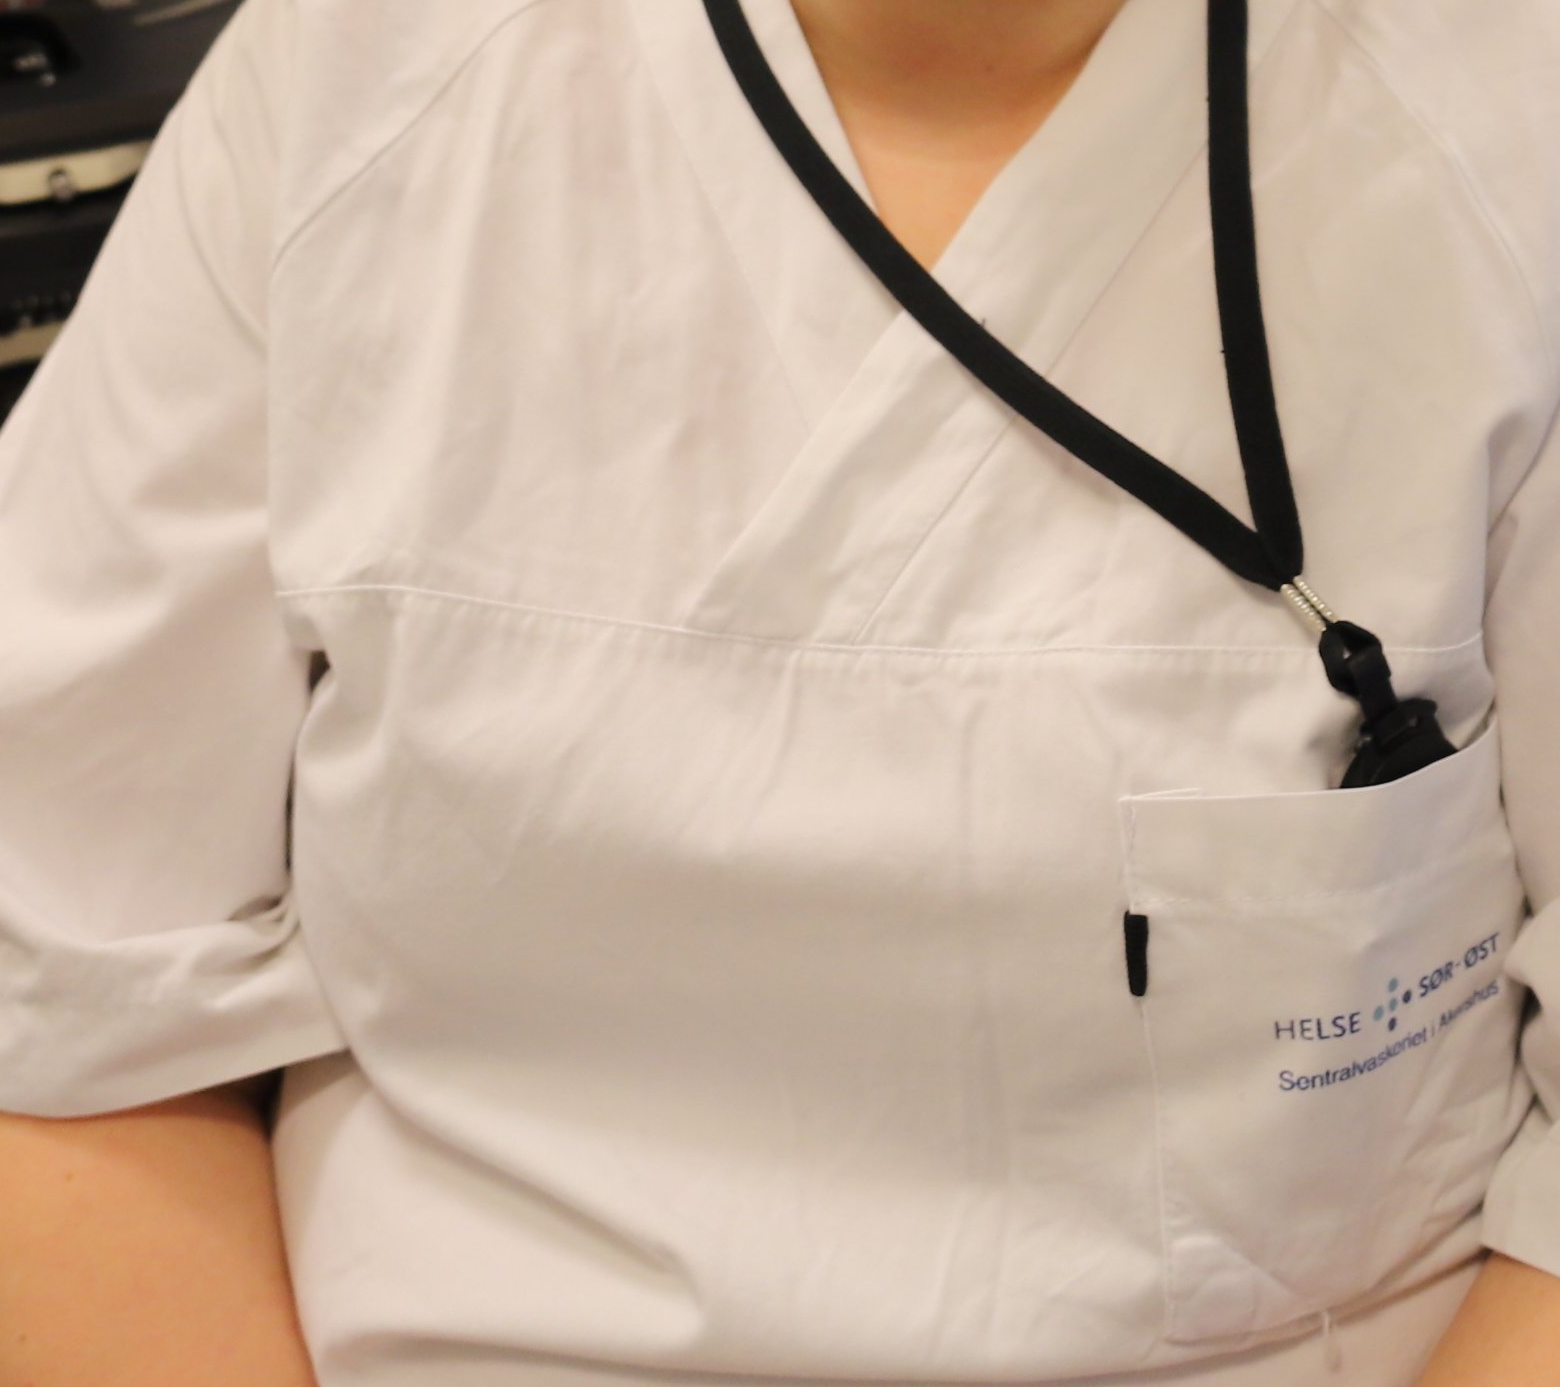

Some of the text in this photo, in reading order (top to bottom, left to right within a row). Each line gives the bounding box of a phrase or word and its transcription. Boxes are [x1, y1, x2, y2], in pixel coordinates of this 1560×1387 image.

[1273, 931, 1500, 1041] HELSE SØR-ØST
[1278, 1027, 1428, 1092] Sentralvaskeriet
